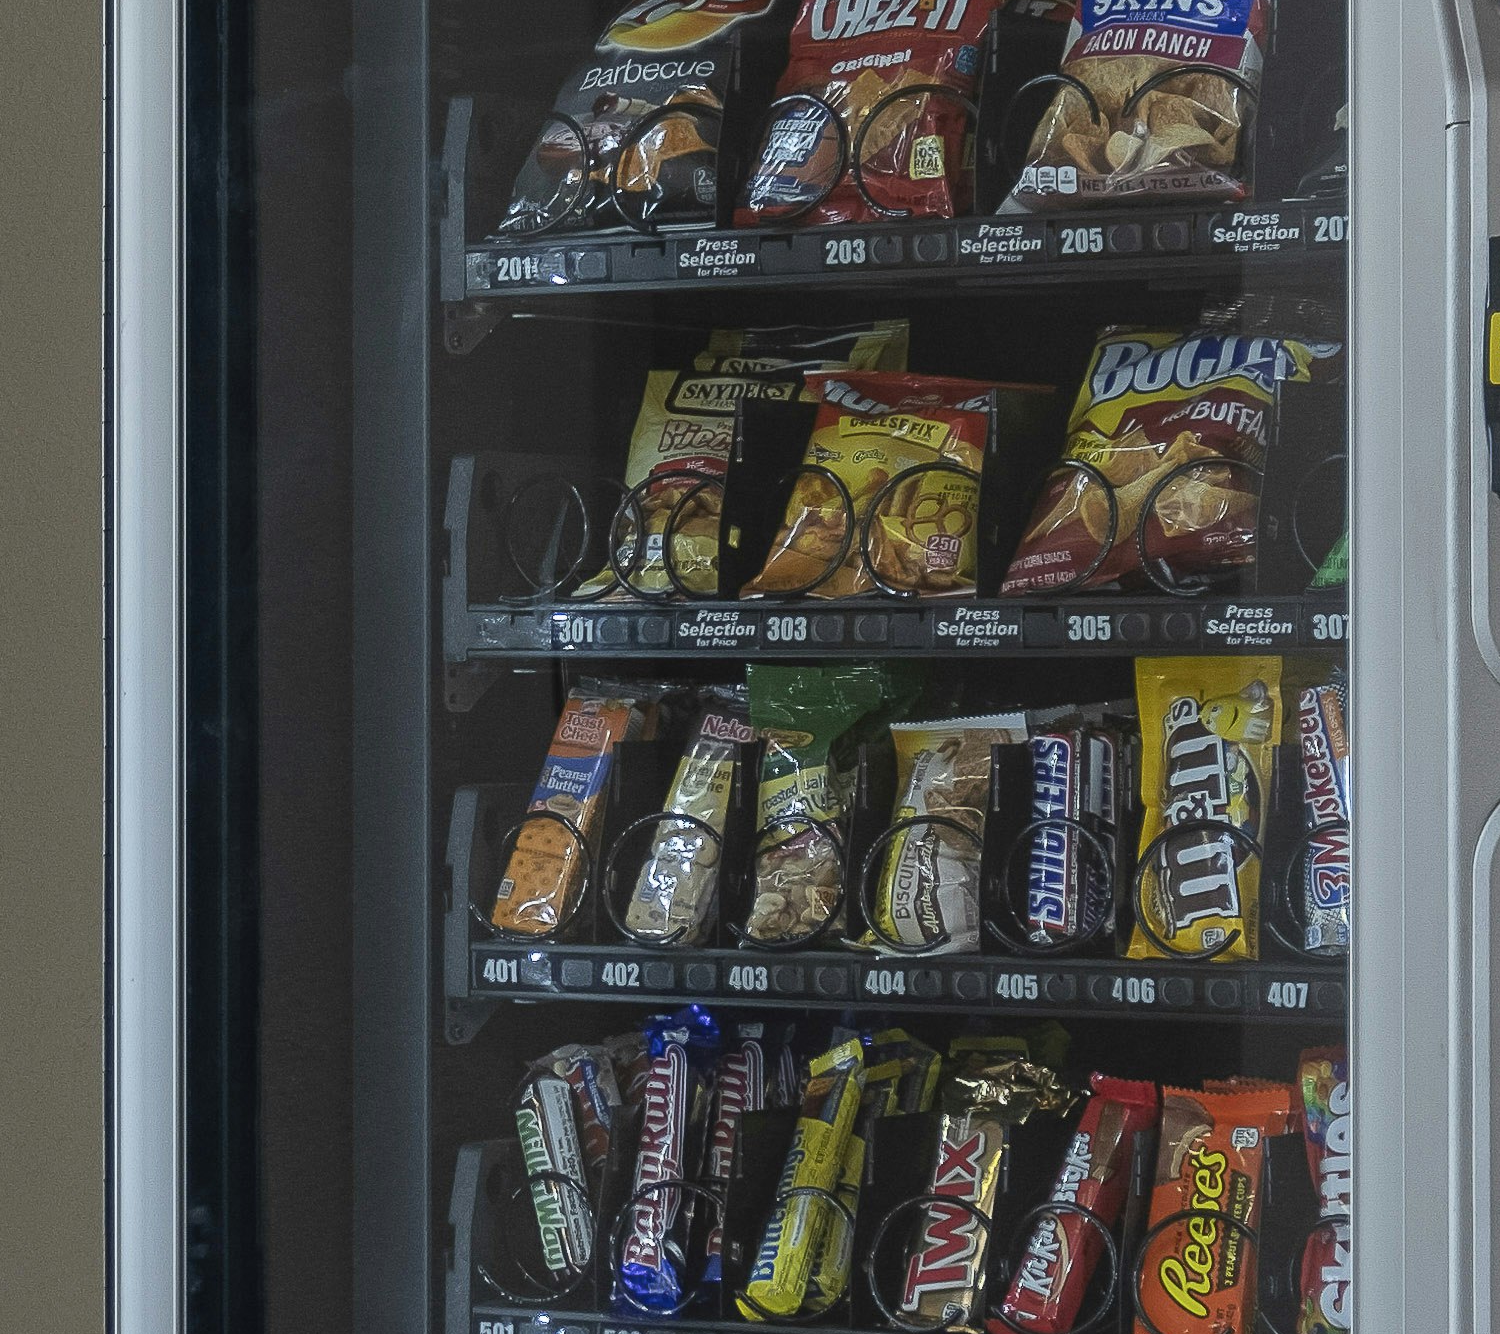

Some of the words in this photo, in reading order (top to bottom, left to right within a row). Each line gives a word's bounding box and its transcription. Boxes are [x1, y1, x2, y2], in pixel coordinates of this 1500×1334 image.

[1082, 29, 1140, 57] BACON
[1141, 29, 1214, 59] RANCH
[578, 59, 716, 92] Barbecue
[979, 224, 1024, 242] Press
[1231, 213, 1280, 230] Press
[959, 237, 1042, 255] Selection
[1060, 228, 1103, 255] 205
[1212, 225, 1300, 245] Selection
[678, 251, 756, 268] Selection
[695, 240, 739, 256] Press
[824, 239, 867, 266] 203
[496, 257, 536, 282] 201
[714, 267, 739, 277] Price
[911, 420, 938, 441] FIX
[927, 536, 961, 553] 250
[697, 609, 740, 625] Press
[955, 608, 1001, 622] Press
[1226, 605, 1274, 620] Press
[559, 615, 594, 644] 301
[678, 621, 756, 640] Selection
[767, 615, 807, 643] 303
[936, 619, 1019, 638] Selection
[1068, 615, 1112, 642] 305
[1206, 617, 1294, 636] Selection
[699, 713, 758, 744] Neko
[550, 764, 594, 782] Peanut
[1028, 739, 1073, 927] SNICKERS
[1316, 870, 1349, 906] 3
[482, 958, 519, 983] 401
[602, 961, 641, 987] 402
[729, 965, 770, 991] 403
[865, 969, 907, 995] 404
[996, 973, 1039, 999] 405
[1111, 977, 1155, 1003] 406
[1267, 982, 1309, 1008] 407
[1236, 1175, 1250, 1198] CUPS
[901, 1130, 986, 1313] TWIX
[1159, 1141, 1227, 1319] Reese's
